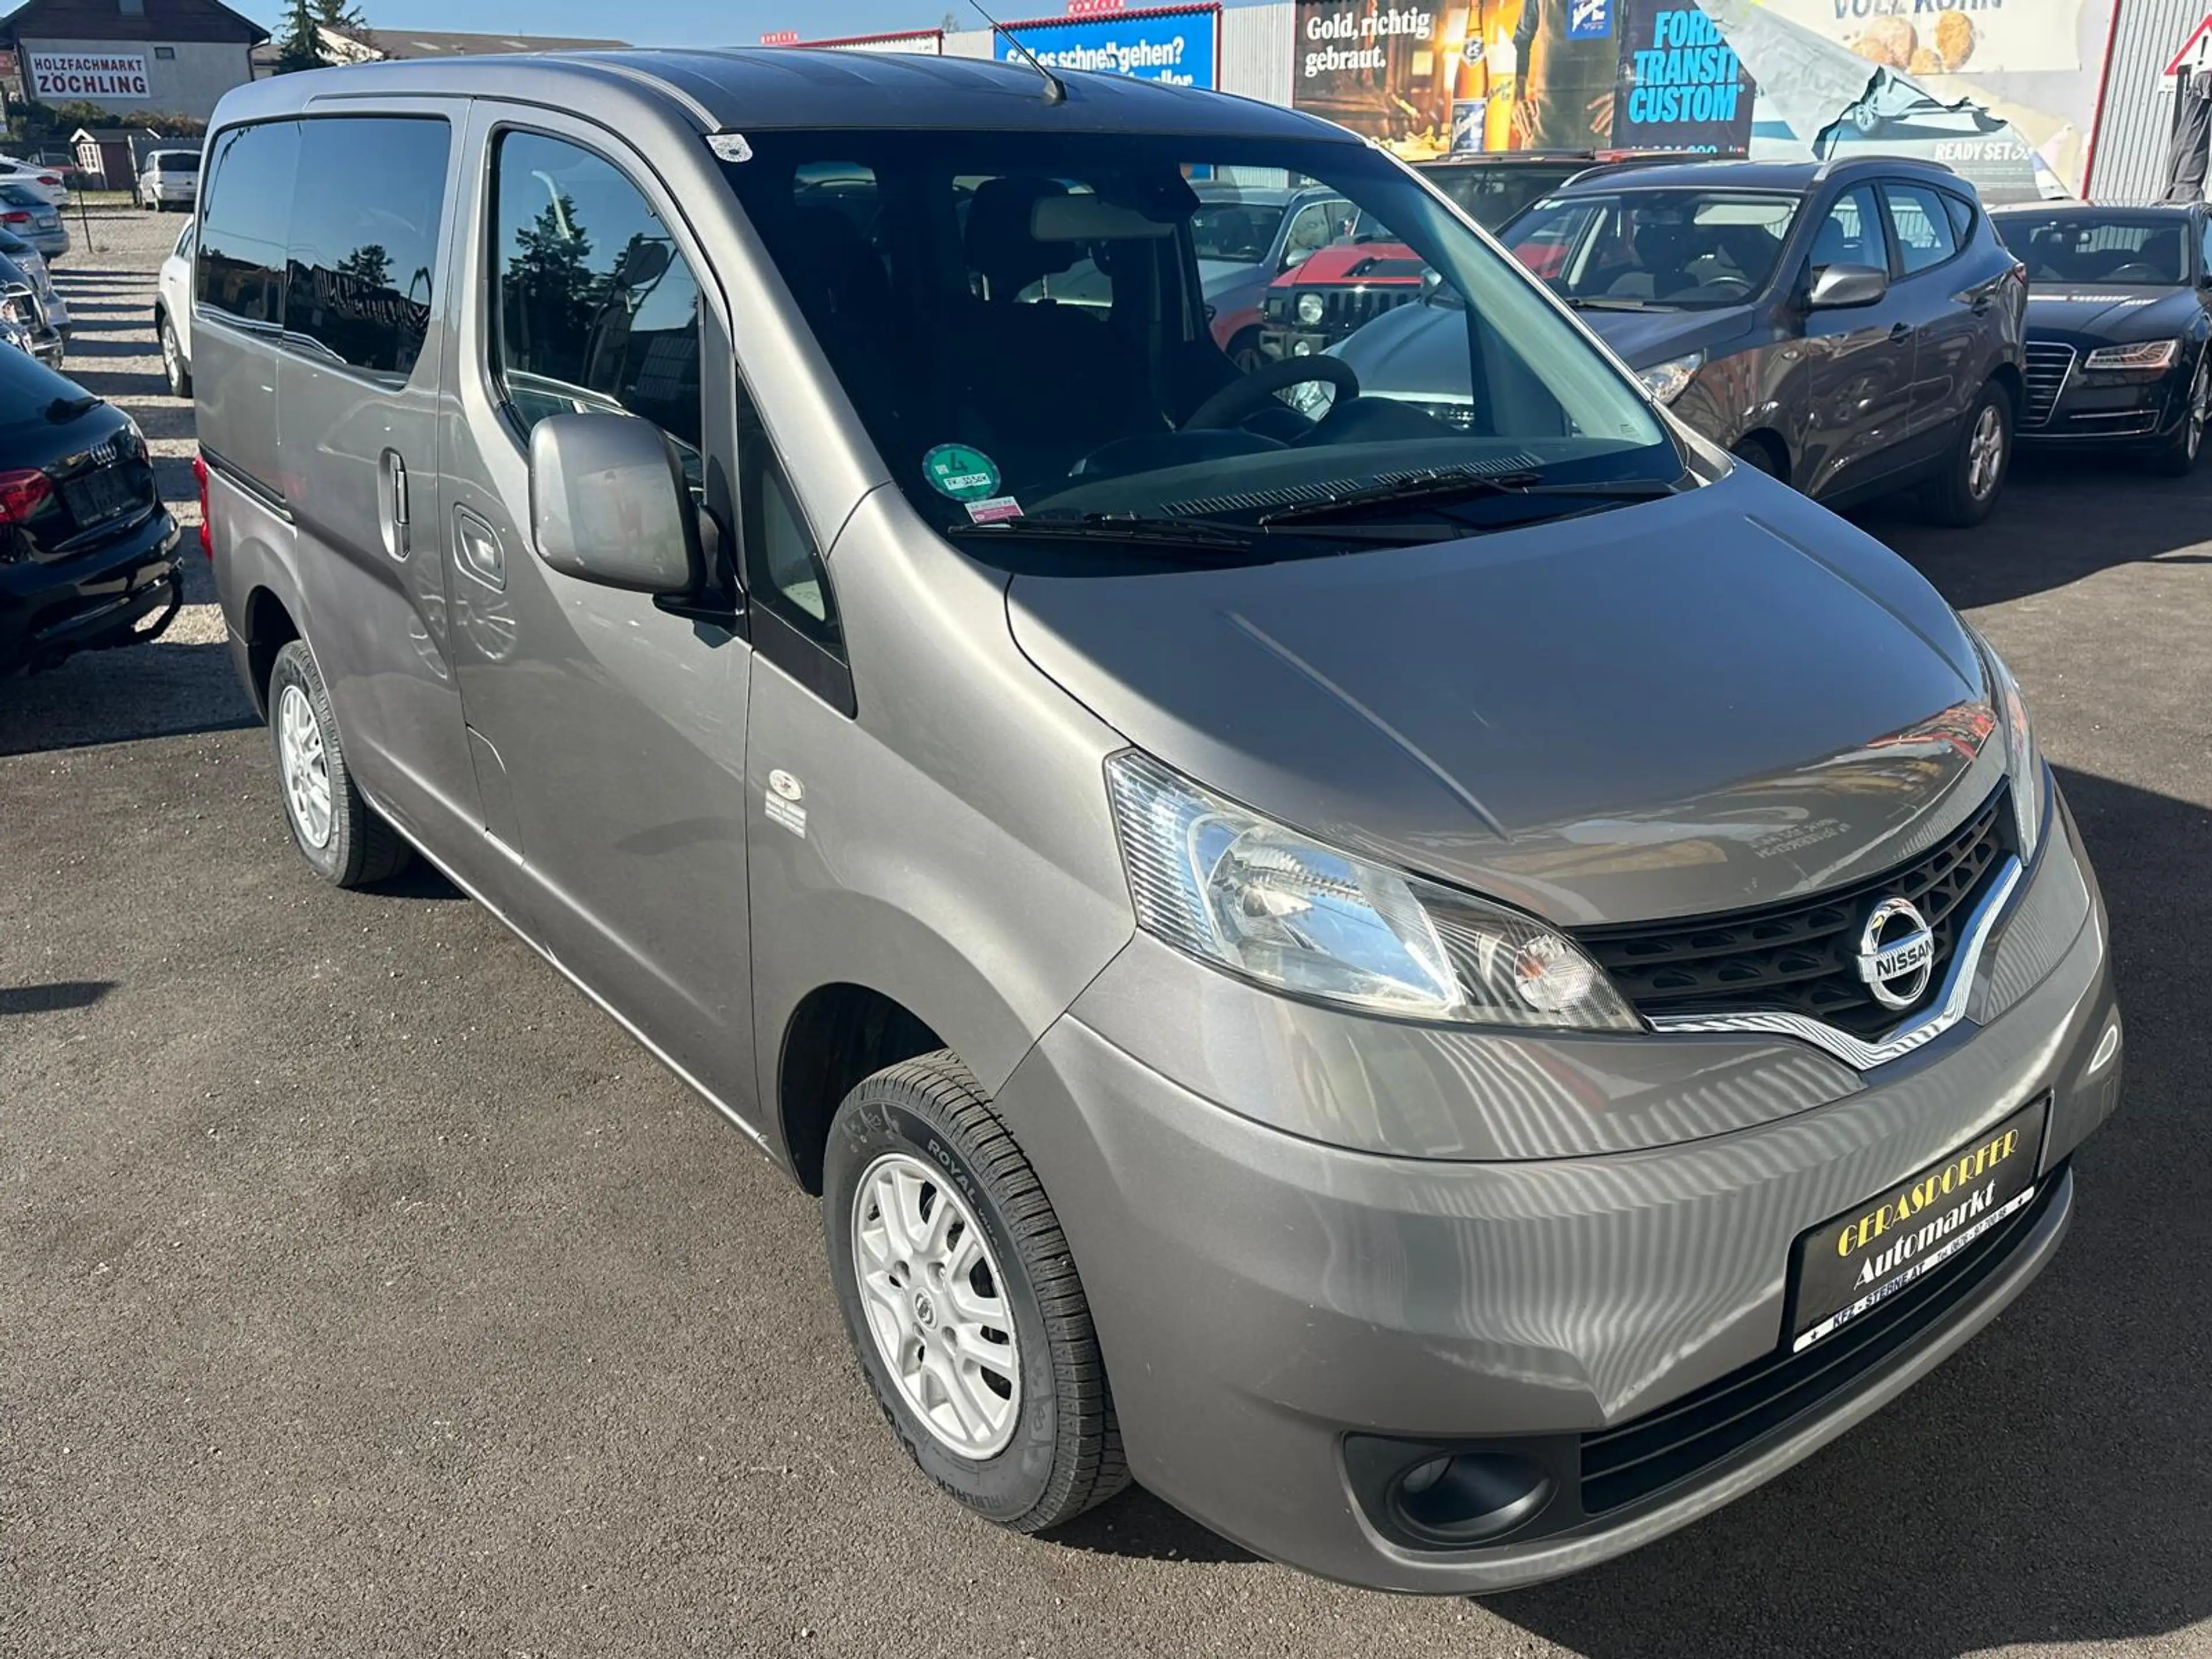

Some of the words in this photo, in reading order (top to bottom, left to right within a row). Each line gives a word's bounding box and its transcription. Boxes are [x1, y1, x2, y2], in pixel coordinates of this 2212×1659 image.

[1307, 12, 1358, 40] Gold,
[1361, 6, 1430, 39] richtig
[34, 58, 142, 71] HOLZFACHMARKT
[1118, 36, 1185, 73] gehen?
[1305, 46, 1386, 77] gebraut.
[37, 72, 147, 93] ZÖCHLING
[1935, 142, 1983, 161] READY
[1984, 142, 2013, 161] SET
[951, 452, 968, 472] 4
[1876, 940, 1931, 976] NISSAN
[927, 1138, 976, 1204] ROYAL
[1838, 1128, 2018, 1257] GERASDORFER
[1853, 1179, 1995, 1291] Automarkt
[1832, 1305, 1855, 1328] KFZ
